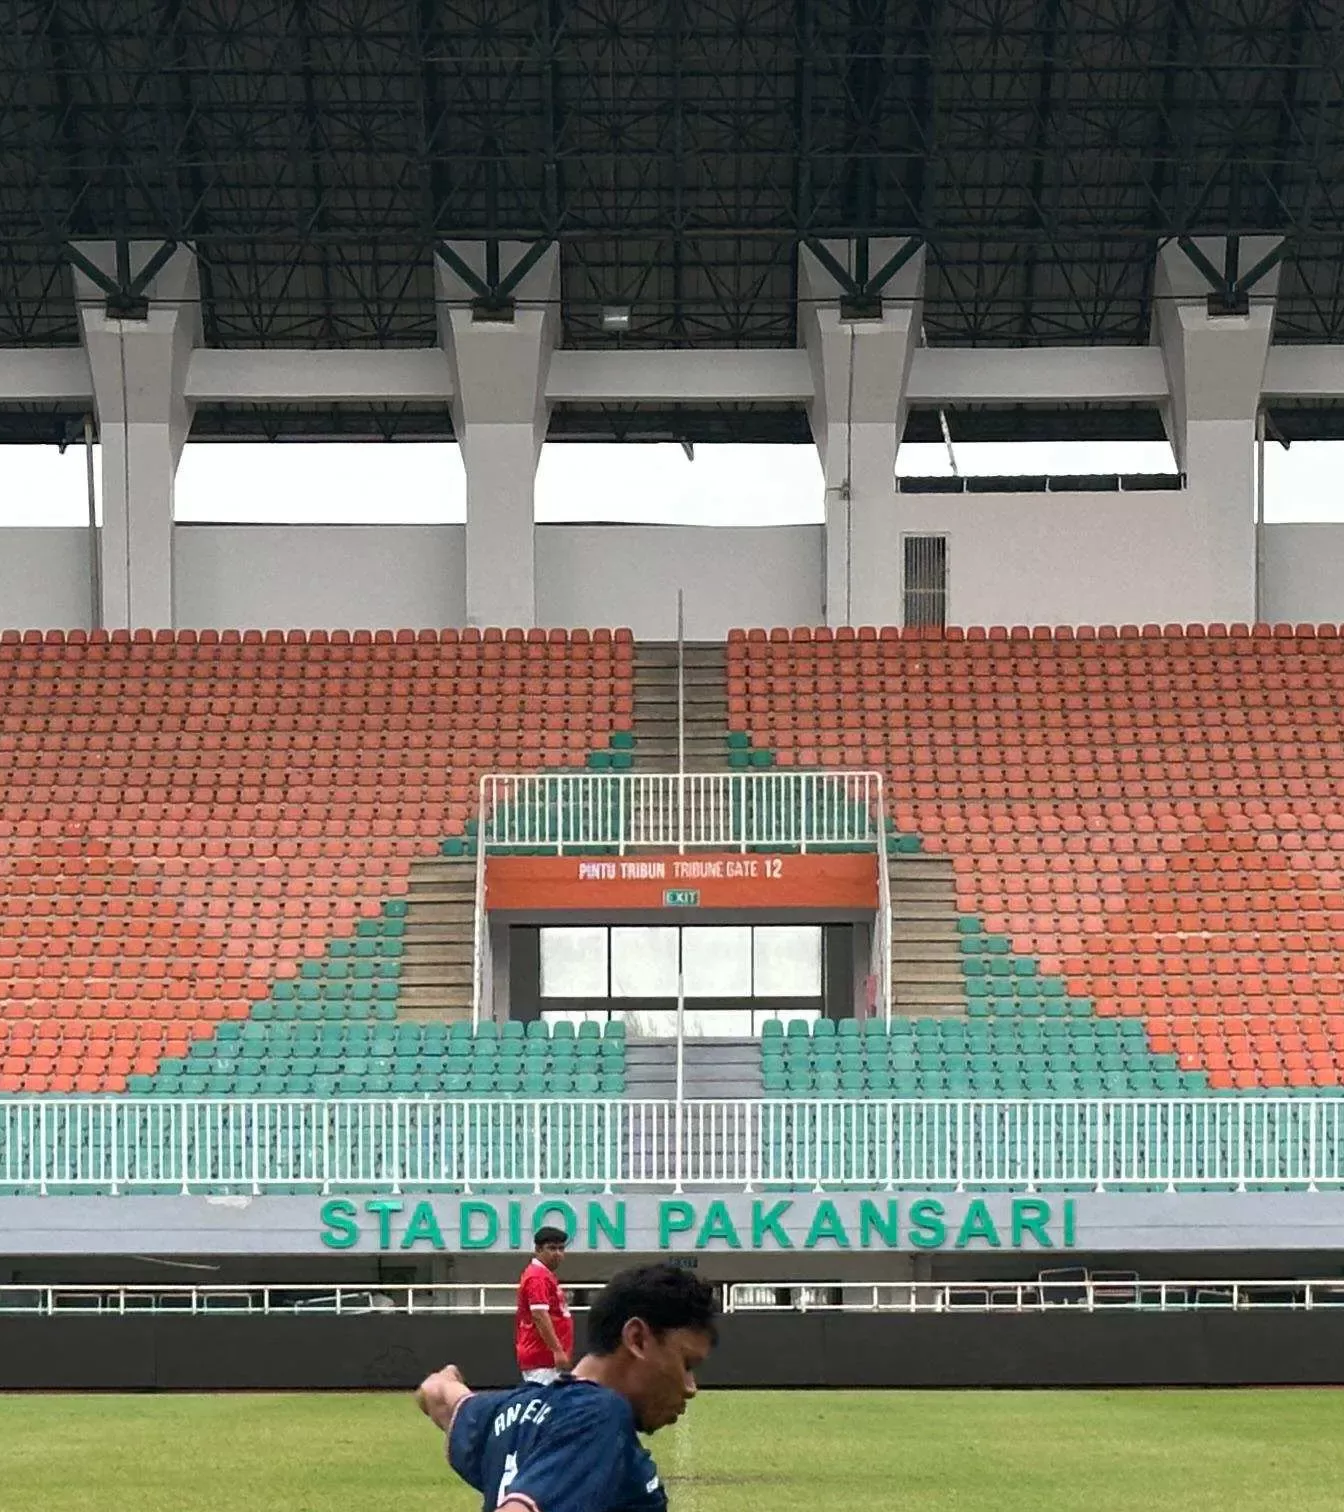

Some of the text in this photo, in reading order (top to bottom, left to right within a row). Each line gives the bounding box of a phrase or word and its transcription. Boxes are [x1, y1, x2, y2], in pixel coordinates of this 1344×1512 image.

[579, 859, 783, 880] PINTU TRIBUN TRIBUNE GATE 12
[666, 891, 697, 904] EXIT
[320, 1198, 1075, 1250] STADION PAKANSARI
